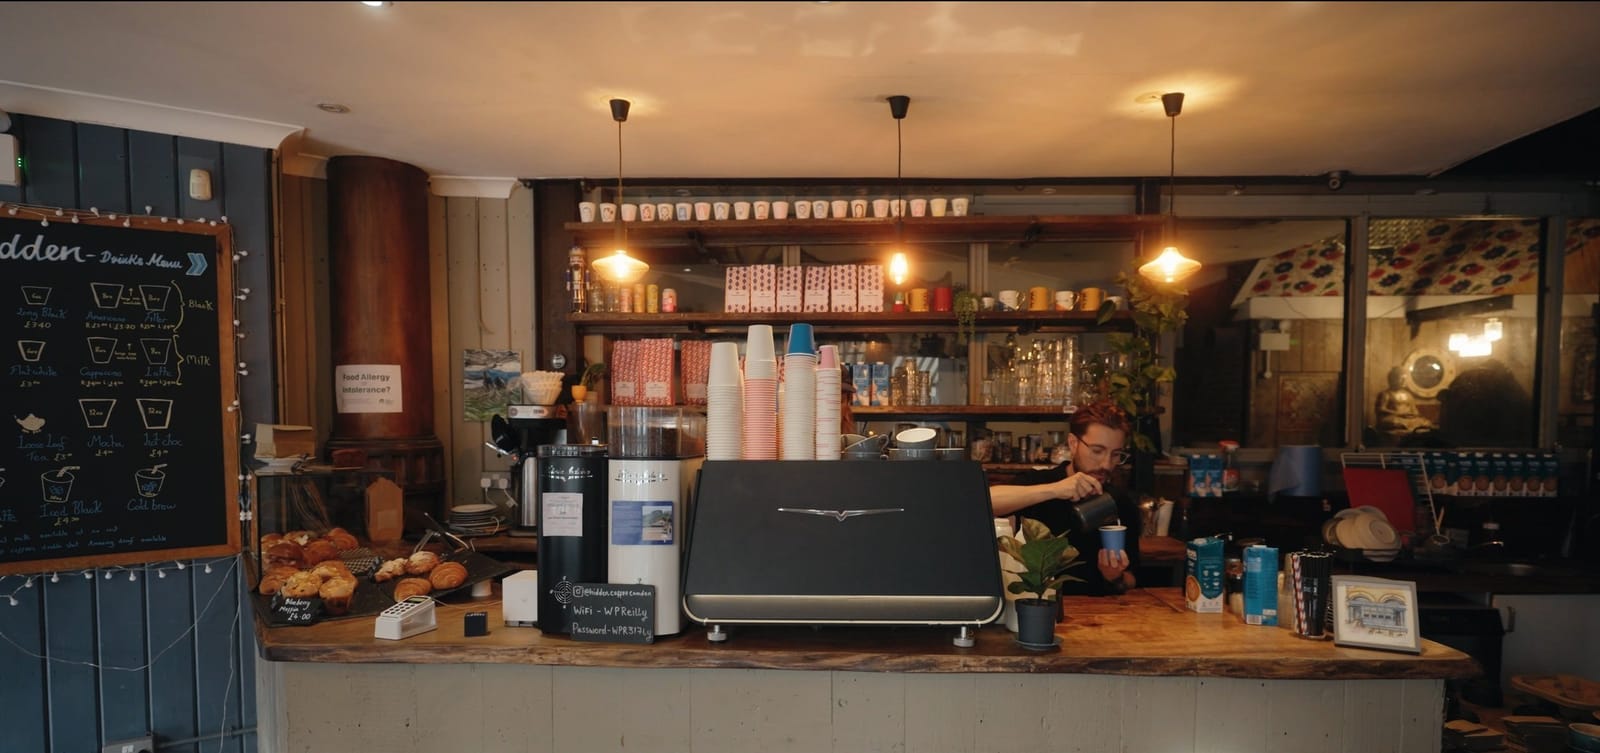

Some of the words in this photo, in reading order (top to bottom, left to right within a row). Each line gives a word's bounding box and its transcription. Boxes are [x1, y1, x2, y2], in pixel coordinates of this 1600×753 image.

[99, 250, 144, 266] Drinks
[146, 253, 183, 269] Menu
[361, 373, 391, 382] Allergy
